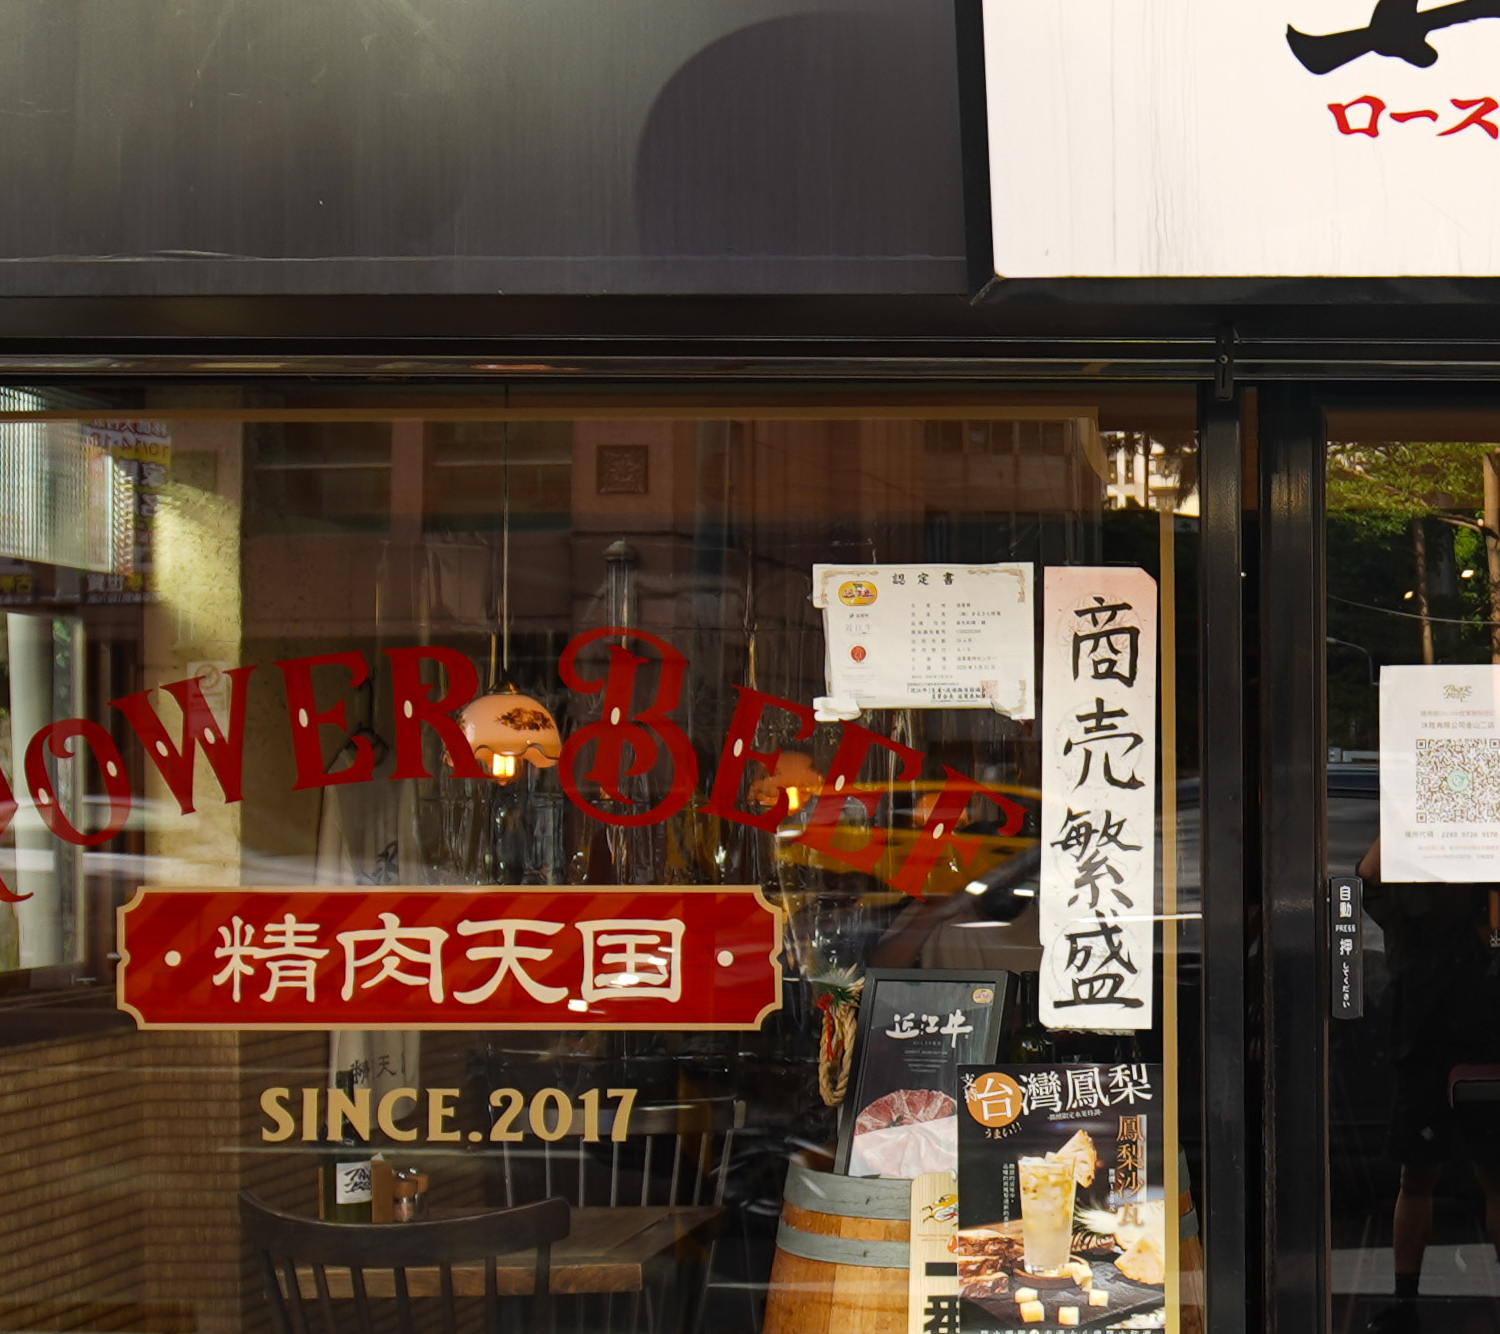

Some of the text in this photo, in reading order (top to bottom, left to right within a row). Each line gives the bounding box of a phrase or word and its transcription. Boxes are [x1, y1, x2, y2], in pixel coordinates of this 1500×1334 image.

[557, 626, 1028, 902] BEEF
[1050, 595, 1145, 1010] 商売繁盛
[1335, 924, 1357, 933] PRESS
[212, 911, 686, 1006] 精肉天国
[885, 1009, 974, 1048] 近江牛
[260, 1087, 638, 1143] SINCE.2017
[977, 1063, 1153, 1121] 台灣鳳梨
